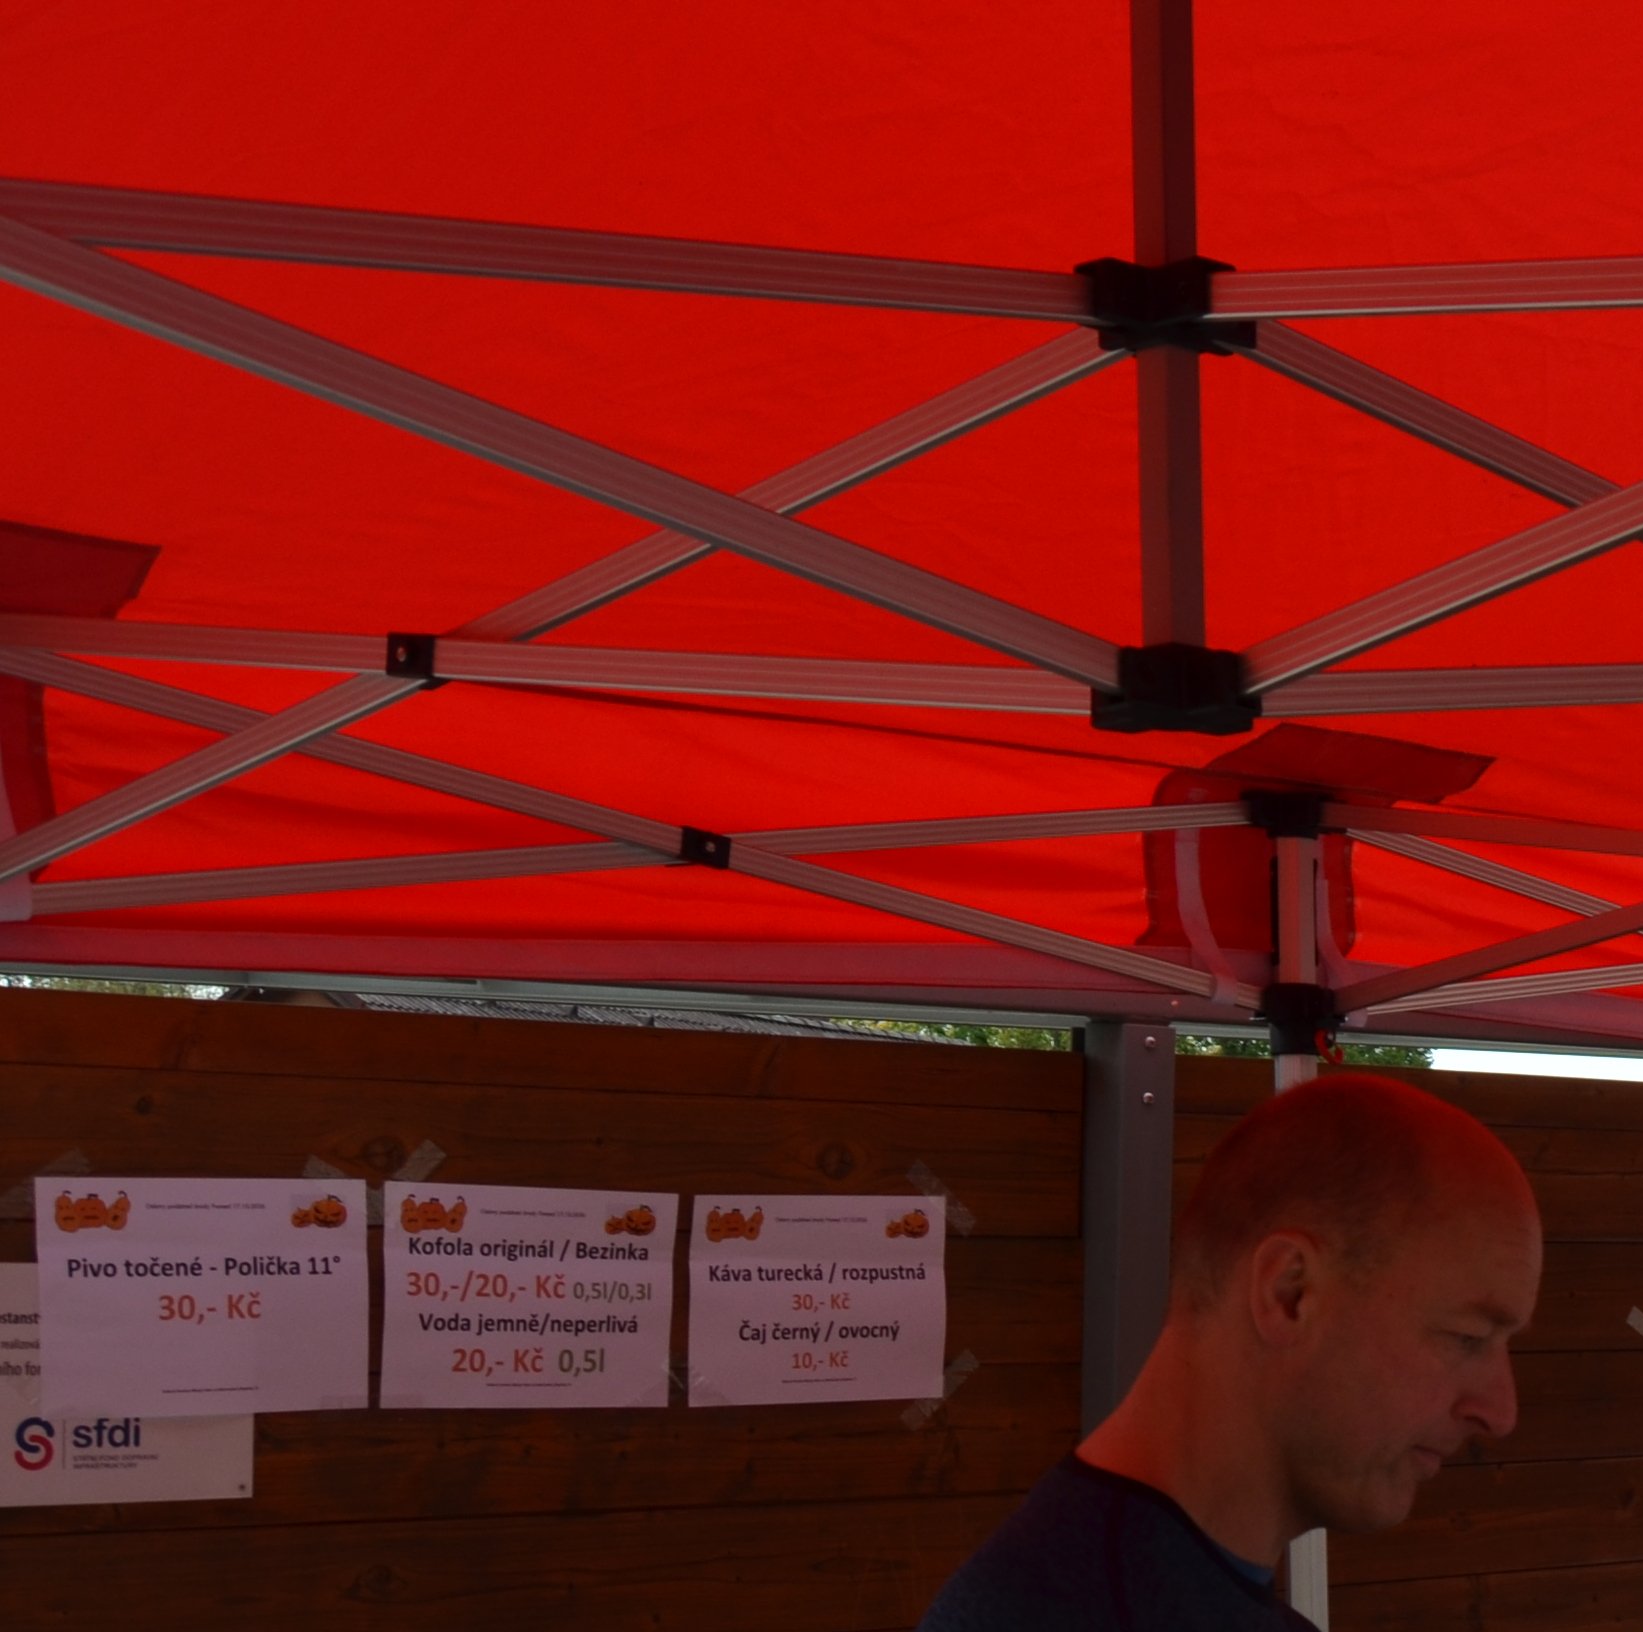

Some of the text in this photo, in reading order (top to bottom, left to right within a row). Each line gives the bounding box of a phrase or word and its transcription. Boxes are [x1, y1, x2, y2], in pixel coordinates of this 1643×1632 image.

[408, 1237, 649, 1261] Kofola originál / Bezinka
[67, 1258, 117, 1278] Pivo
[124, 1256, 203, 1278] točené
[224, 1256, 301, 1276] Polička
[308, 1255, 341, 1275] 11°
[709, 1262, 925, 1284] Káva turecká / rozpustná
[407, 1270, 526, 1302] 30,-/20,-
[536, 1274, 566, 1299] Kč
[159, 1292, 261, 1325] 30,- Kč
[792, 1292, 850, 1313] 30,- Kč
[419, 1313, 638, 1336] Voda jemně/neperlivá
[739, 1320, 900, 1344] Čaj černý / ovocný
[452, 1348, 605, 1377] 20,- Kč 0,5l
[792, 1351, 849, 1371] 10,- Kč
[73, 1417, 140, 1448] sfdi
